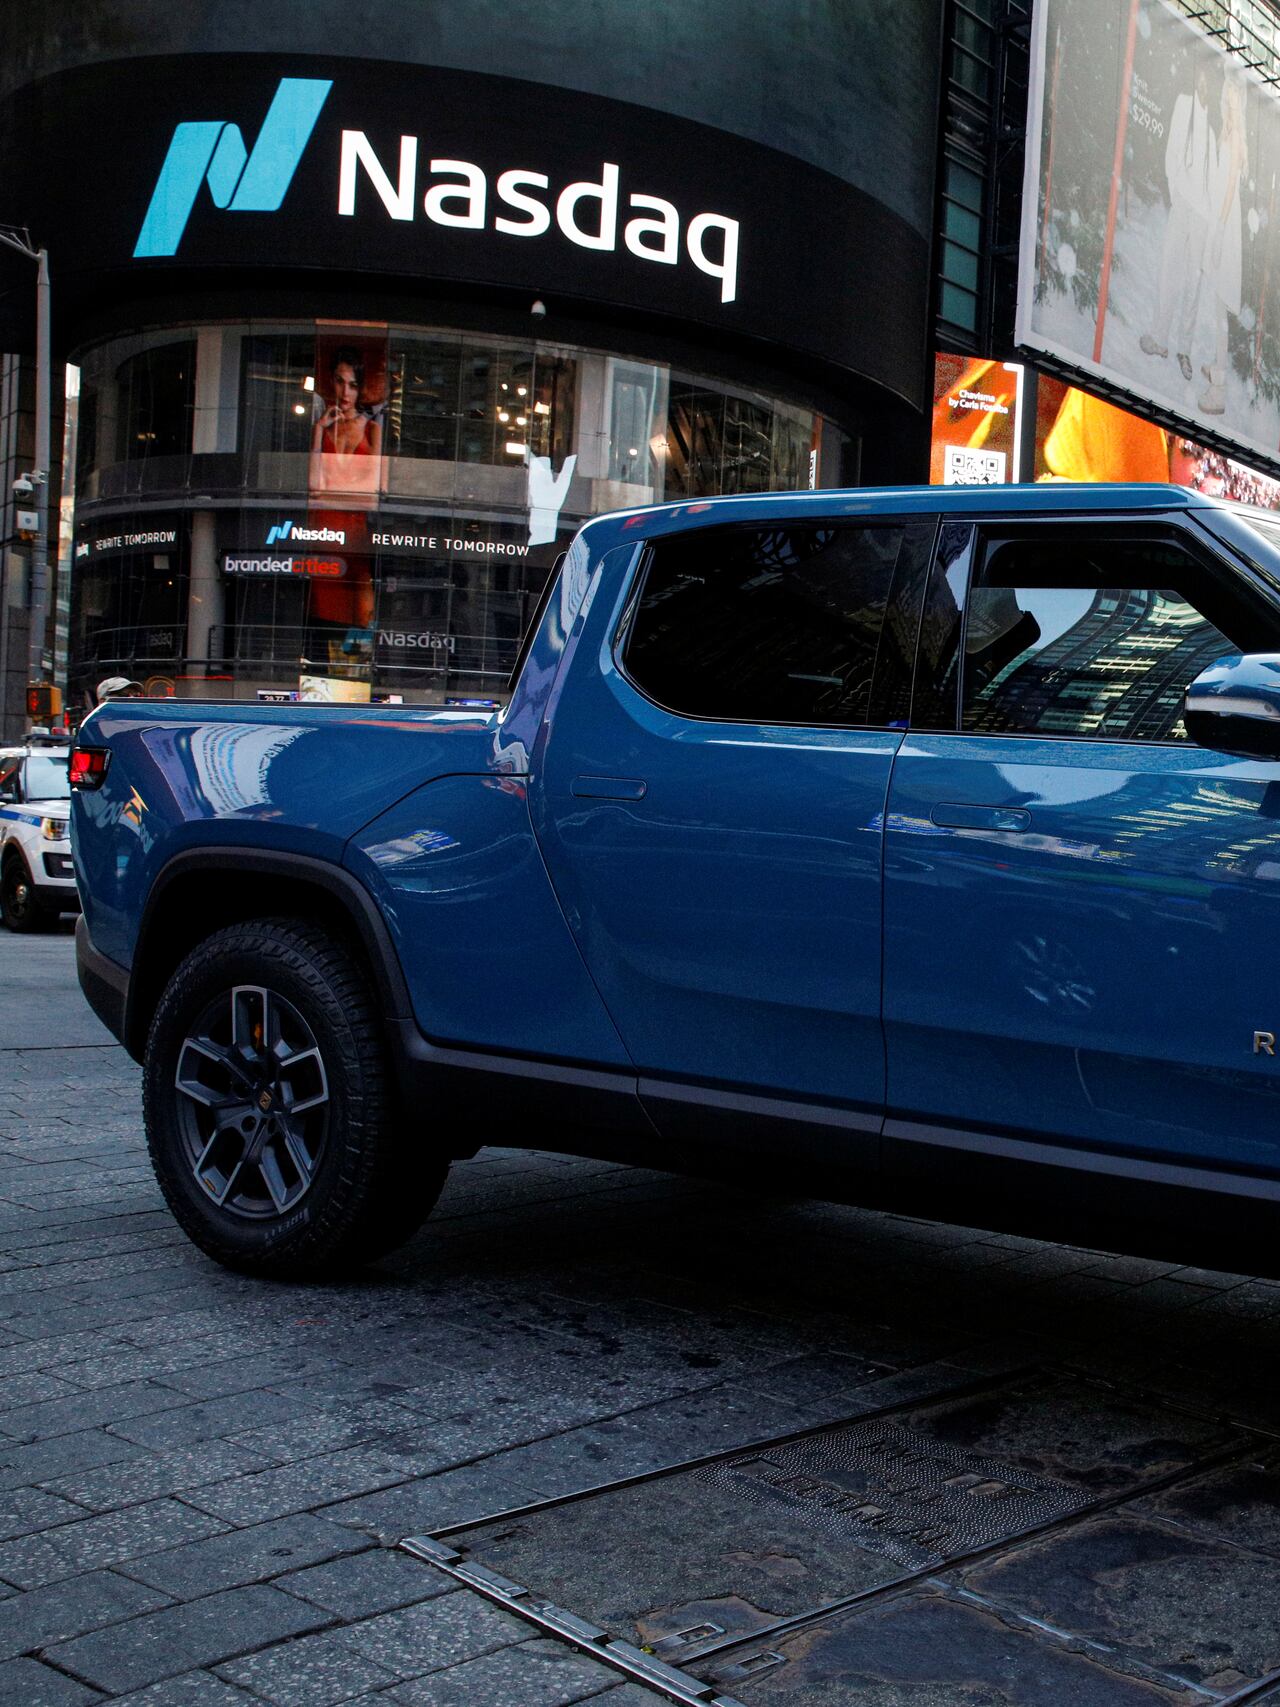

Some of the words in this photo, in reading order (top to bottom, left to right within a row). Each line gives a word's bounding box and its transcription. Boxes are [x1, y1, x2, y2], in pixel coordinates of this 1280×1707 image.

[1132, 104, 1164, 139] $29.99
[338, 129, 740, 304] Nasdaq
[948, 397, 959, 408] by
[96, 535, 122, 551] REWRITE
[124, 531, 176, 546] TOMORROW
[291, 526, 346, 545] Nasdaq
[372, 533, 437, 549] REWRITE
[444, 538, 530, 557] TOMORROW
[225, 556, 342, 576] brandedcities
[378, 630, 456, 654] Nasdaq
